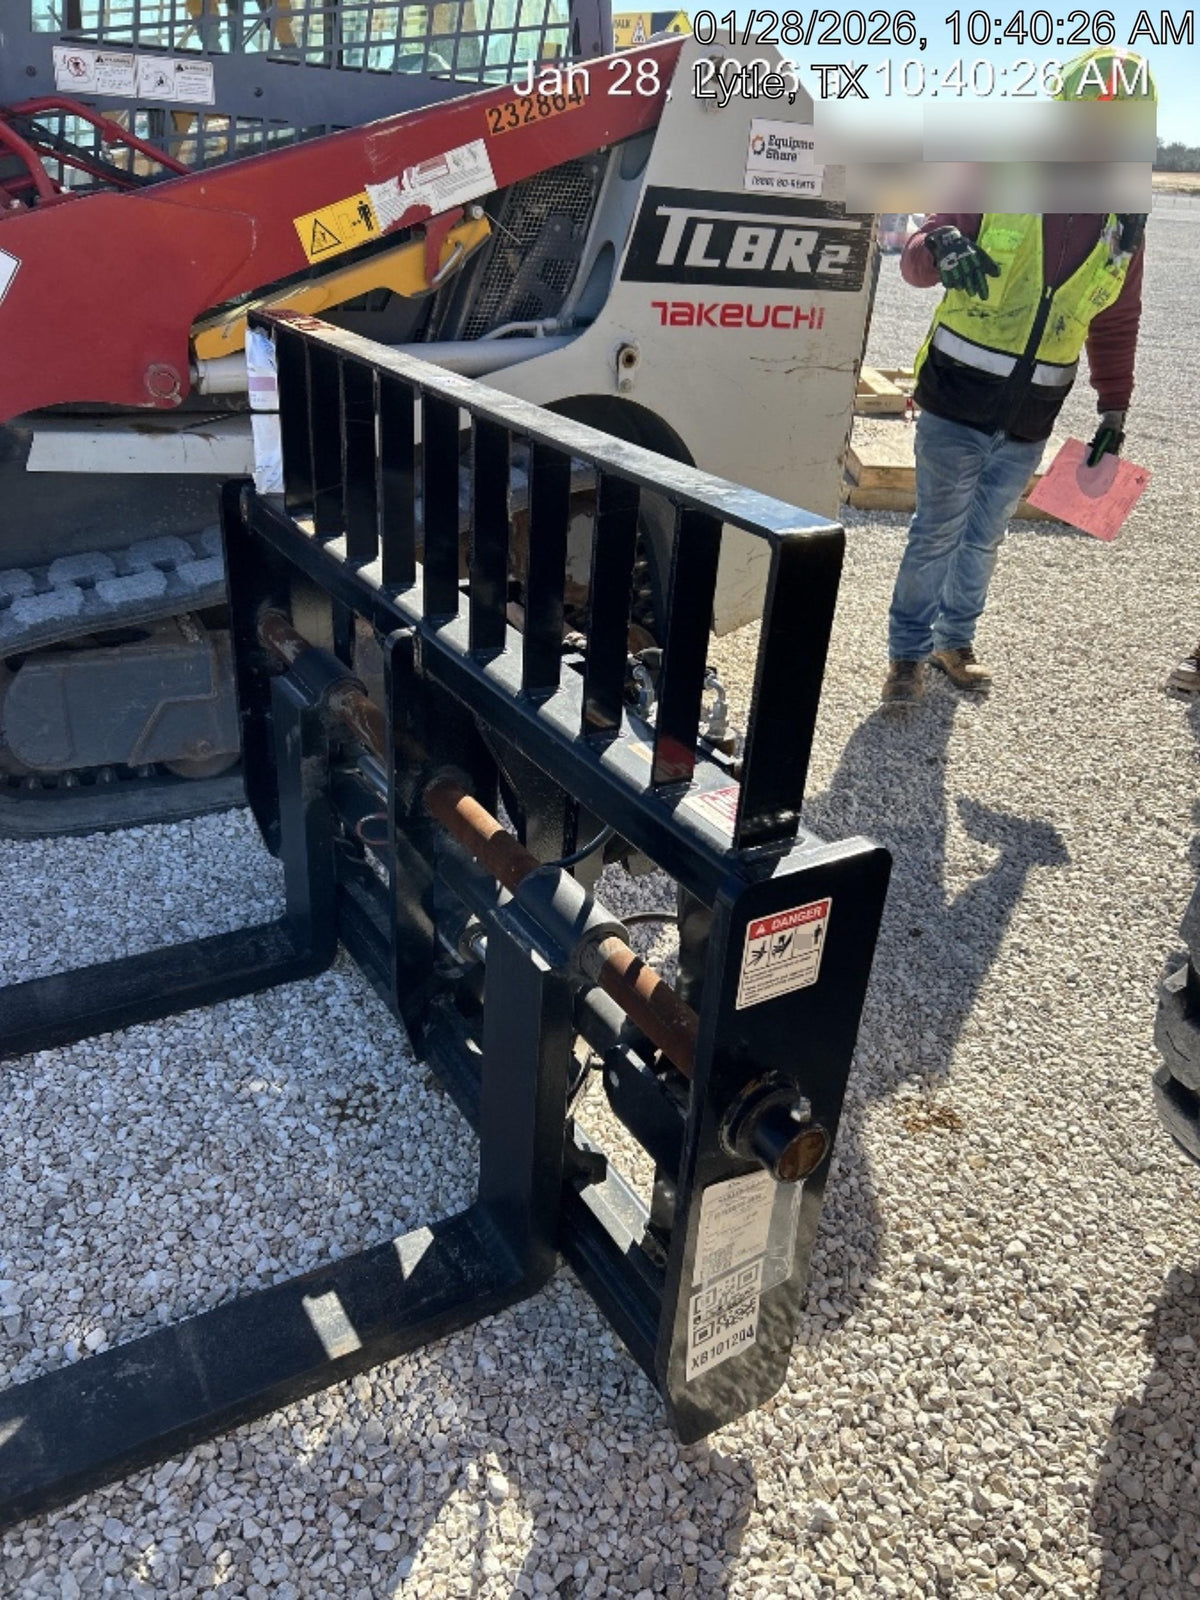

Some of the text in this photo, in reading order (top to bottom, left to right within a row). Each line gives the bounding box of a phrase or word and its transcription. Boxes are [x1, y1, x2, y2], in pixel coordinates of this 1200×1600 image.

[488, 77, 582, 133] 232864
[766, 148, 797, 162] Share
[768, 134, 814, 151] Equipme
[656, 205, 861, 274] TL8R2
[651, 301, 826, 330] TAKEUCHI
[771, 906, 823, 930] DANGER
[691, 1324, 755, 1371] XB101204
